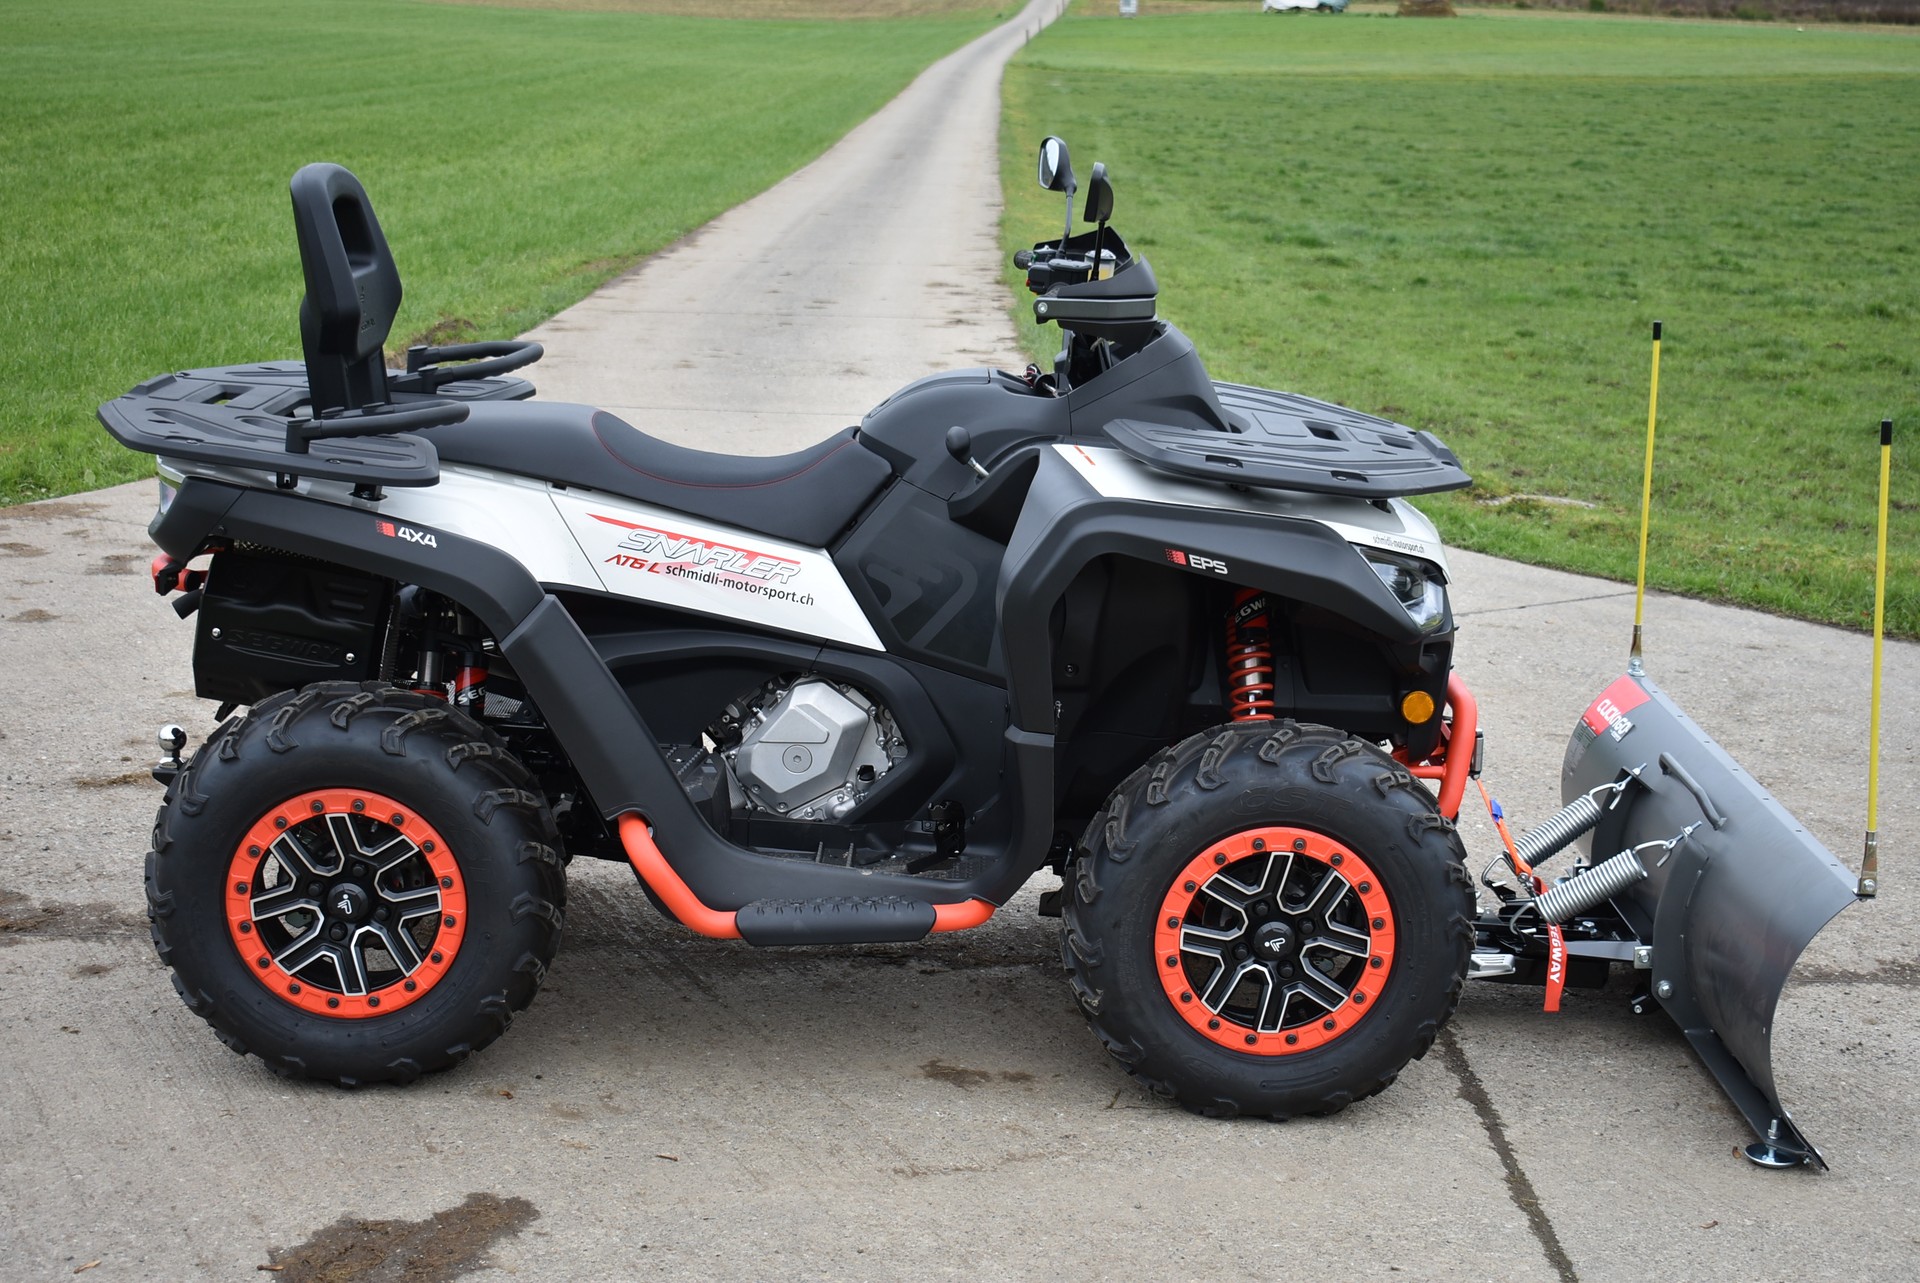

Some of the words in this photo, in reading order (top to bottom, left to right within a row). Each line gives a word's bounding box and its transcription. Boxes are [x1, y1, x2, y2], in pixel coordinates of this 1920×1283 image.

[397, 526, 438, 549] 4X4
[617, 528, 802, 585] SNARLER
[1188, 554, 1229, 575] EPS
[665, 563, 815, 606] schmidli-motorsport.ch
[1235, 597, 1266, 624] EGW
